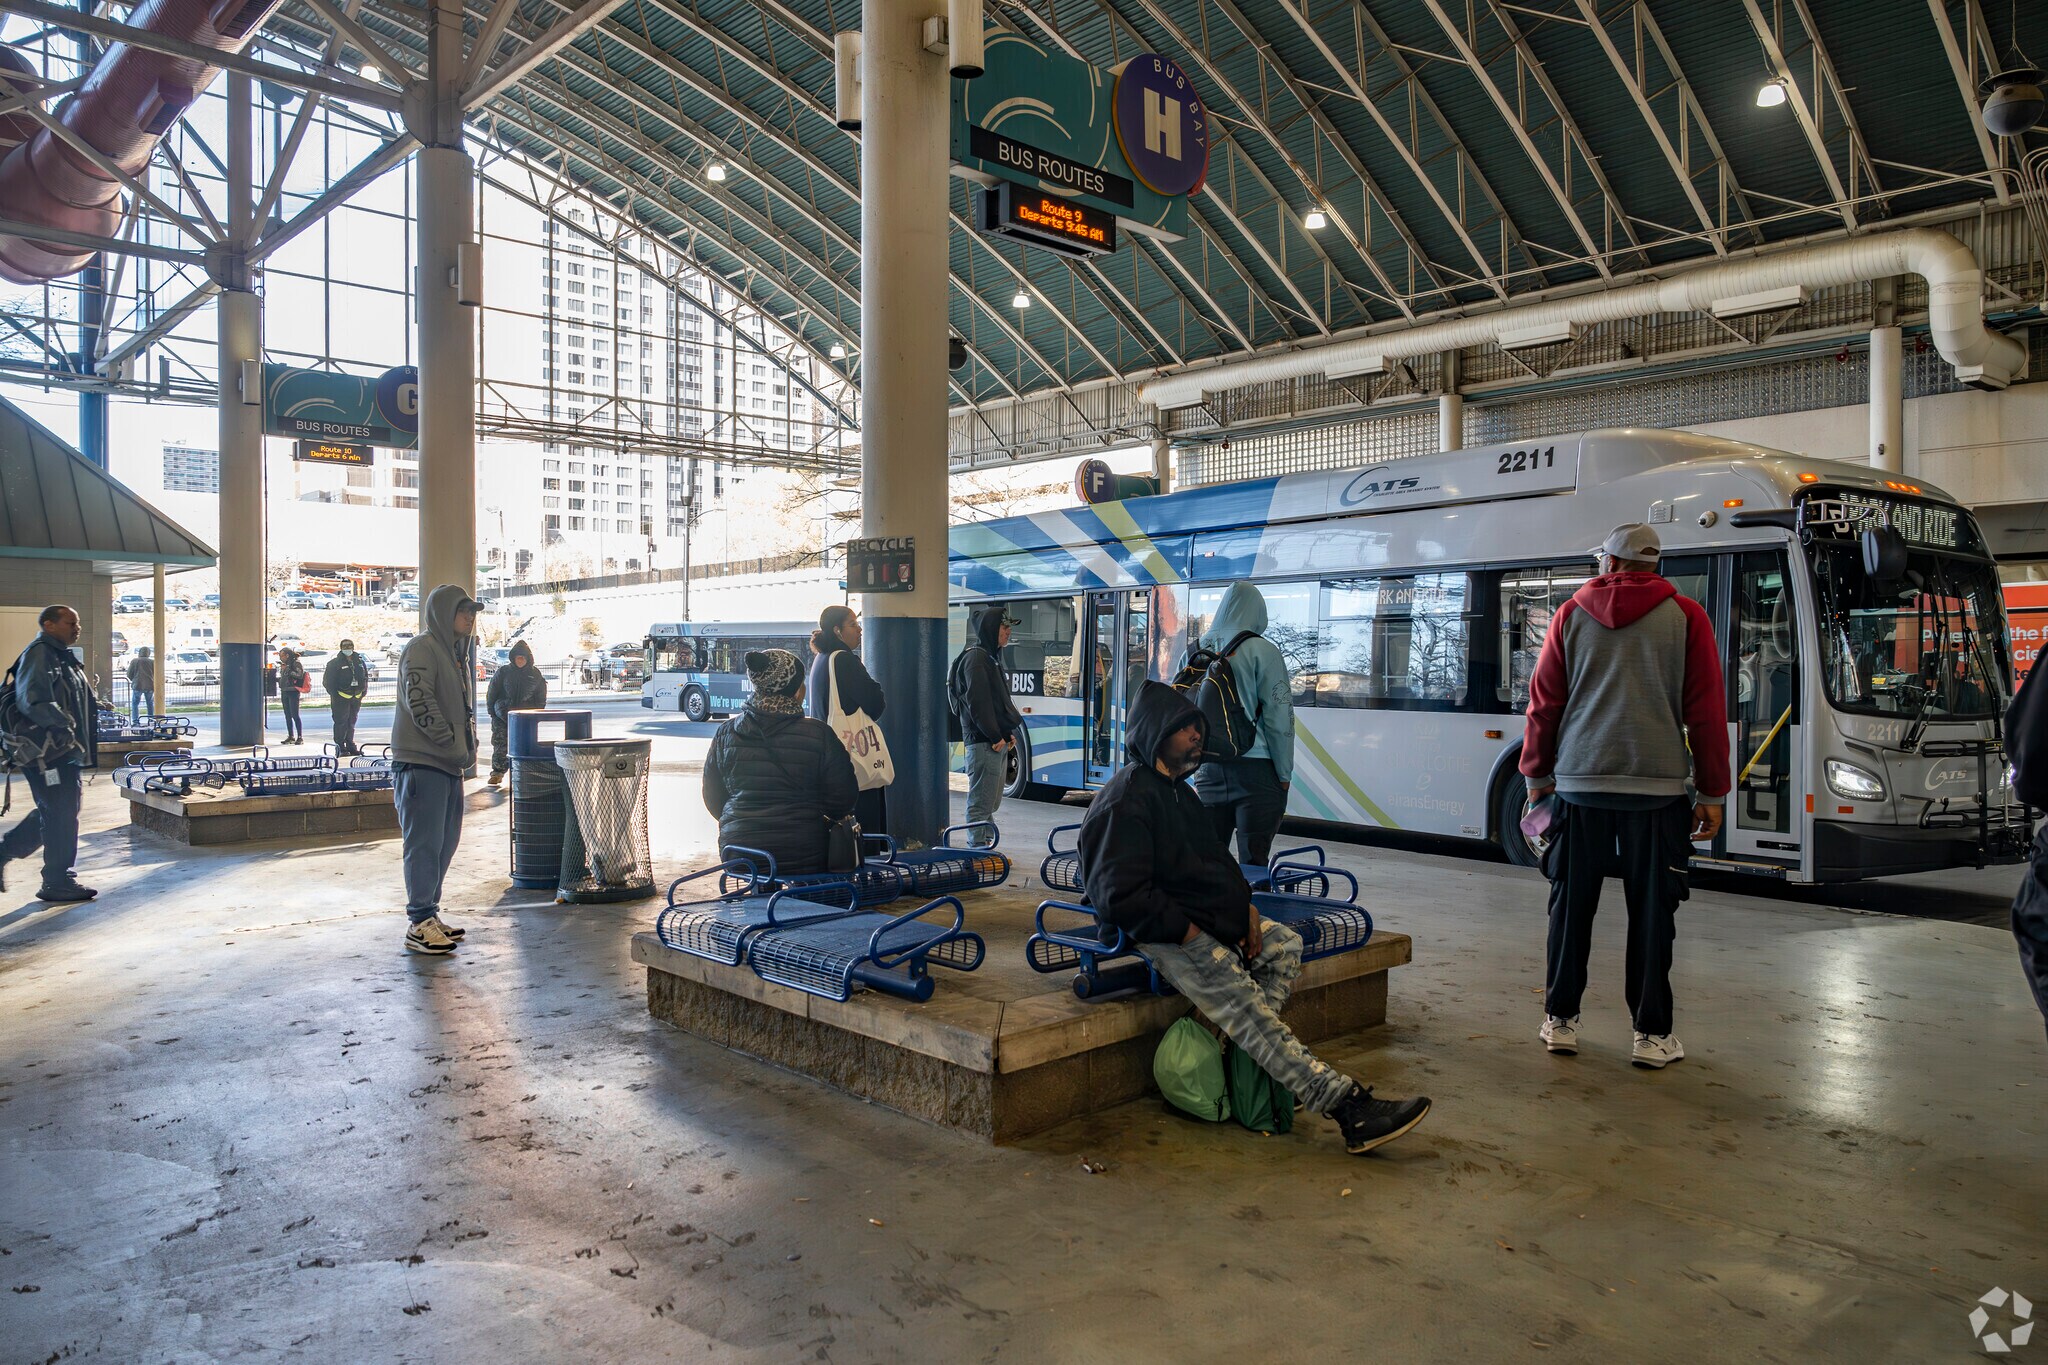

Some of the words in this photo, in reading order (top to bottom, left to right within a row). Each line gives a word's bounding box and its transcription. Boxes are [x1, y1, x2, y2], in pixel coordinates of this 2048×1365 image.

[1153, 58, 1185, 90] BUS
[1189, 101, 1204, 148] BAY
[1143, 87, 1182, 162] H
[998, 141, 1033, 170] BUS
[1038, 155, 1105, 194] ROUTES
[1042, 199, 1073, 221] Route
[1075, 210, 1083, 223] 9
[1019, 205, 1065, 230] Departs
[1065, 220, 1089, 237] 9:45
[1089, 227, 1104, 242] AM
[296, 420, 320, 432] BUS
[323, 423, 370, 437] ROUTES
[310, 450, 341, 460] Departs
[342, 453, 347, 461] 6
[320, 445, 342, 454] Route
[344, 447, 352, 455] 10
[1497, 446, 1555, 474] 2211
[1093, 471, 1105, 494] F
[1340, 466, 1420, 507] CATS
[1892, 503, 1922, 542] AND
[1923, 507, 1957, 547] RIDE
[849, 536, 914, 553] RECYCLE
[1011, 672, 1035, 693] BUS
[709, 695, 730, 708] We're
[1868, 721, 1900, 741] 2211
[1924, 757, 1967, 791] CATS
